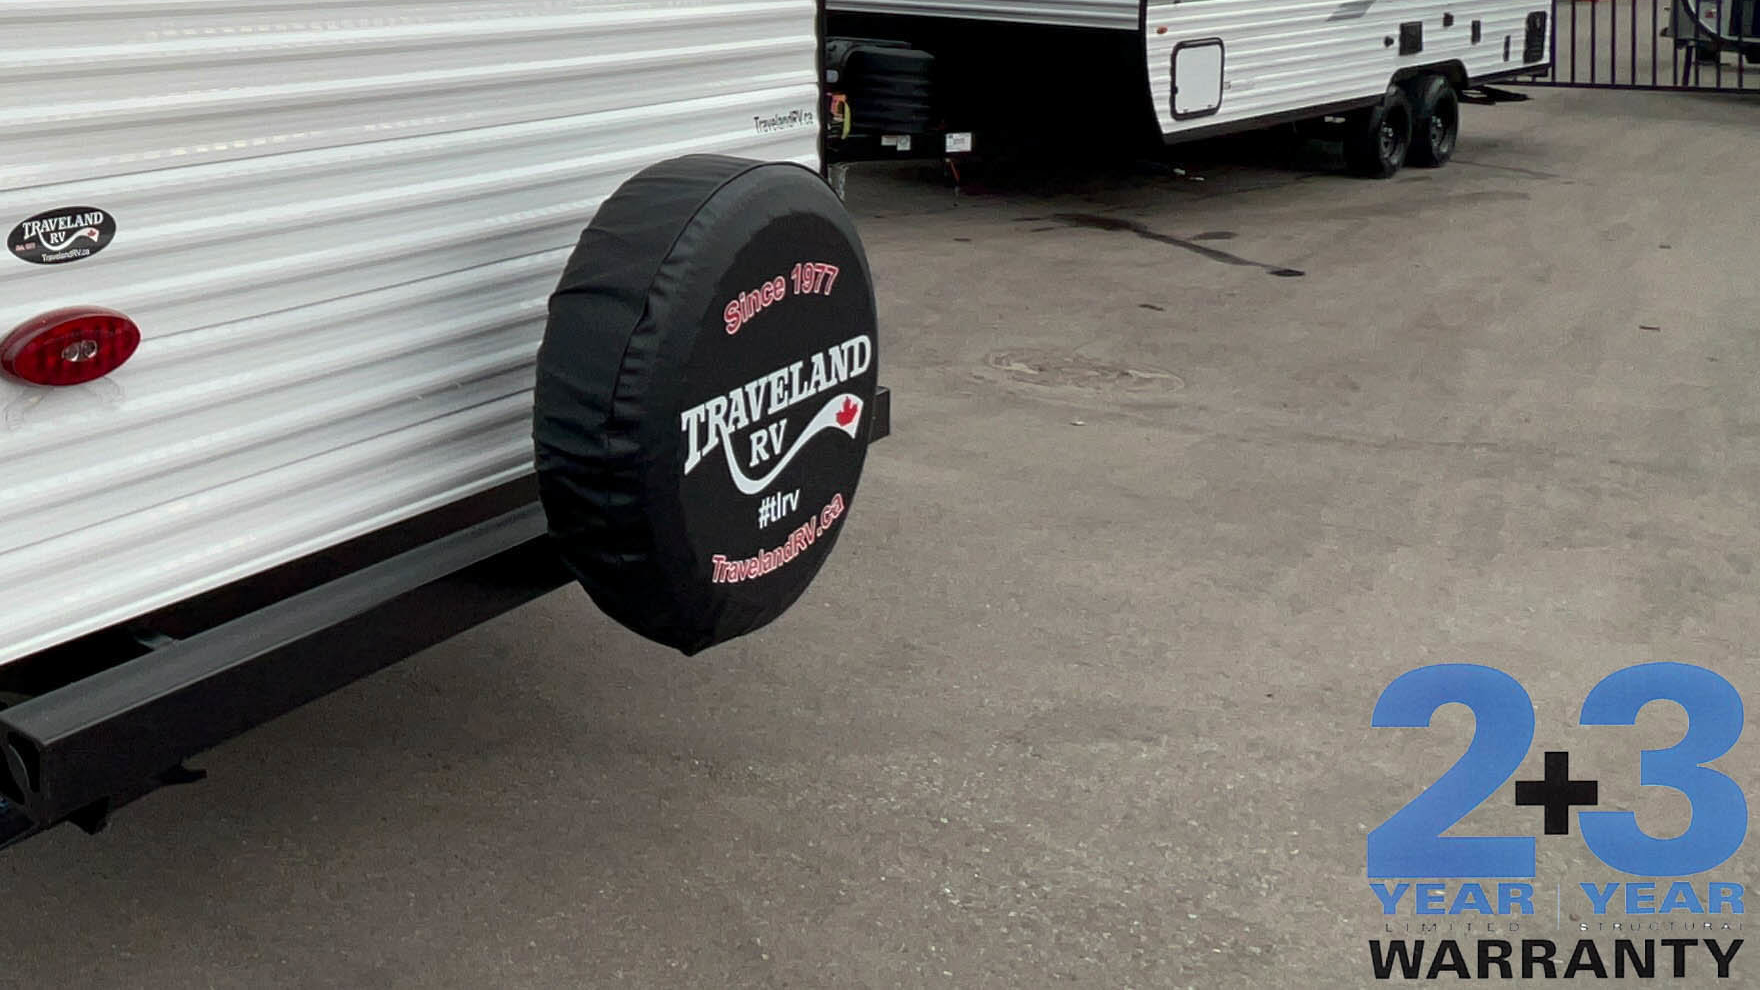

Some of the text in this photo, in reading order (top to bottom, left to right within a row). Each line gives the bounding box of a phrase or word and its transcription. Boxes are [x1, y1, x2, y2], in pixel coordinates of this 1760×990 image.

[22, 212, 104, 240] TRAVELAND
[50, 231, 66, 244] RV
[723, 262, 839, 335] Since 1977
[681, 335, 871, 476] TRAVELAND
[749, 418, 788, 468] RV
[758, 489, 800, 529] #tlrv
[711, 493, 845, 583] TravelandRV.ca
